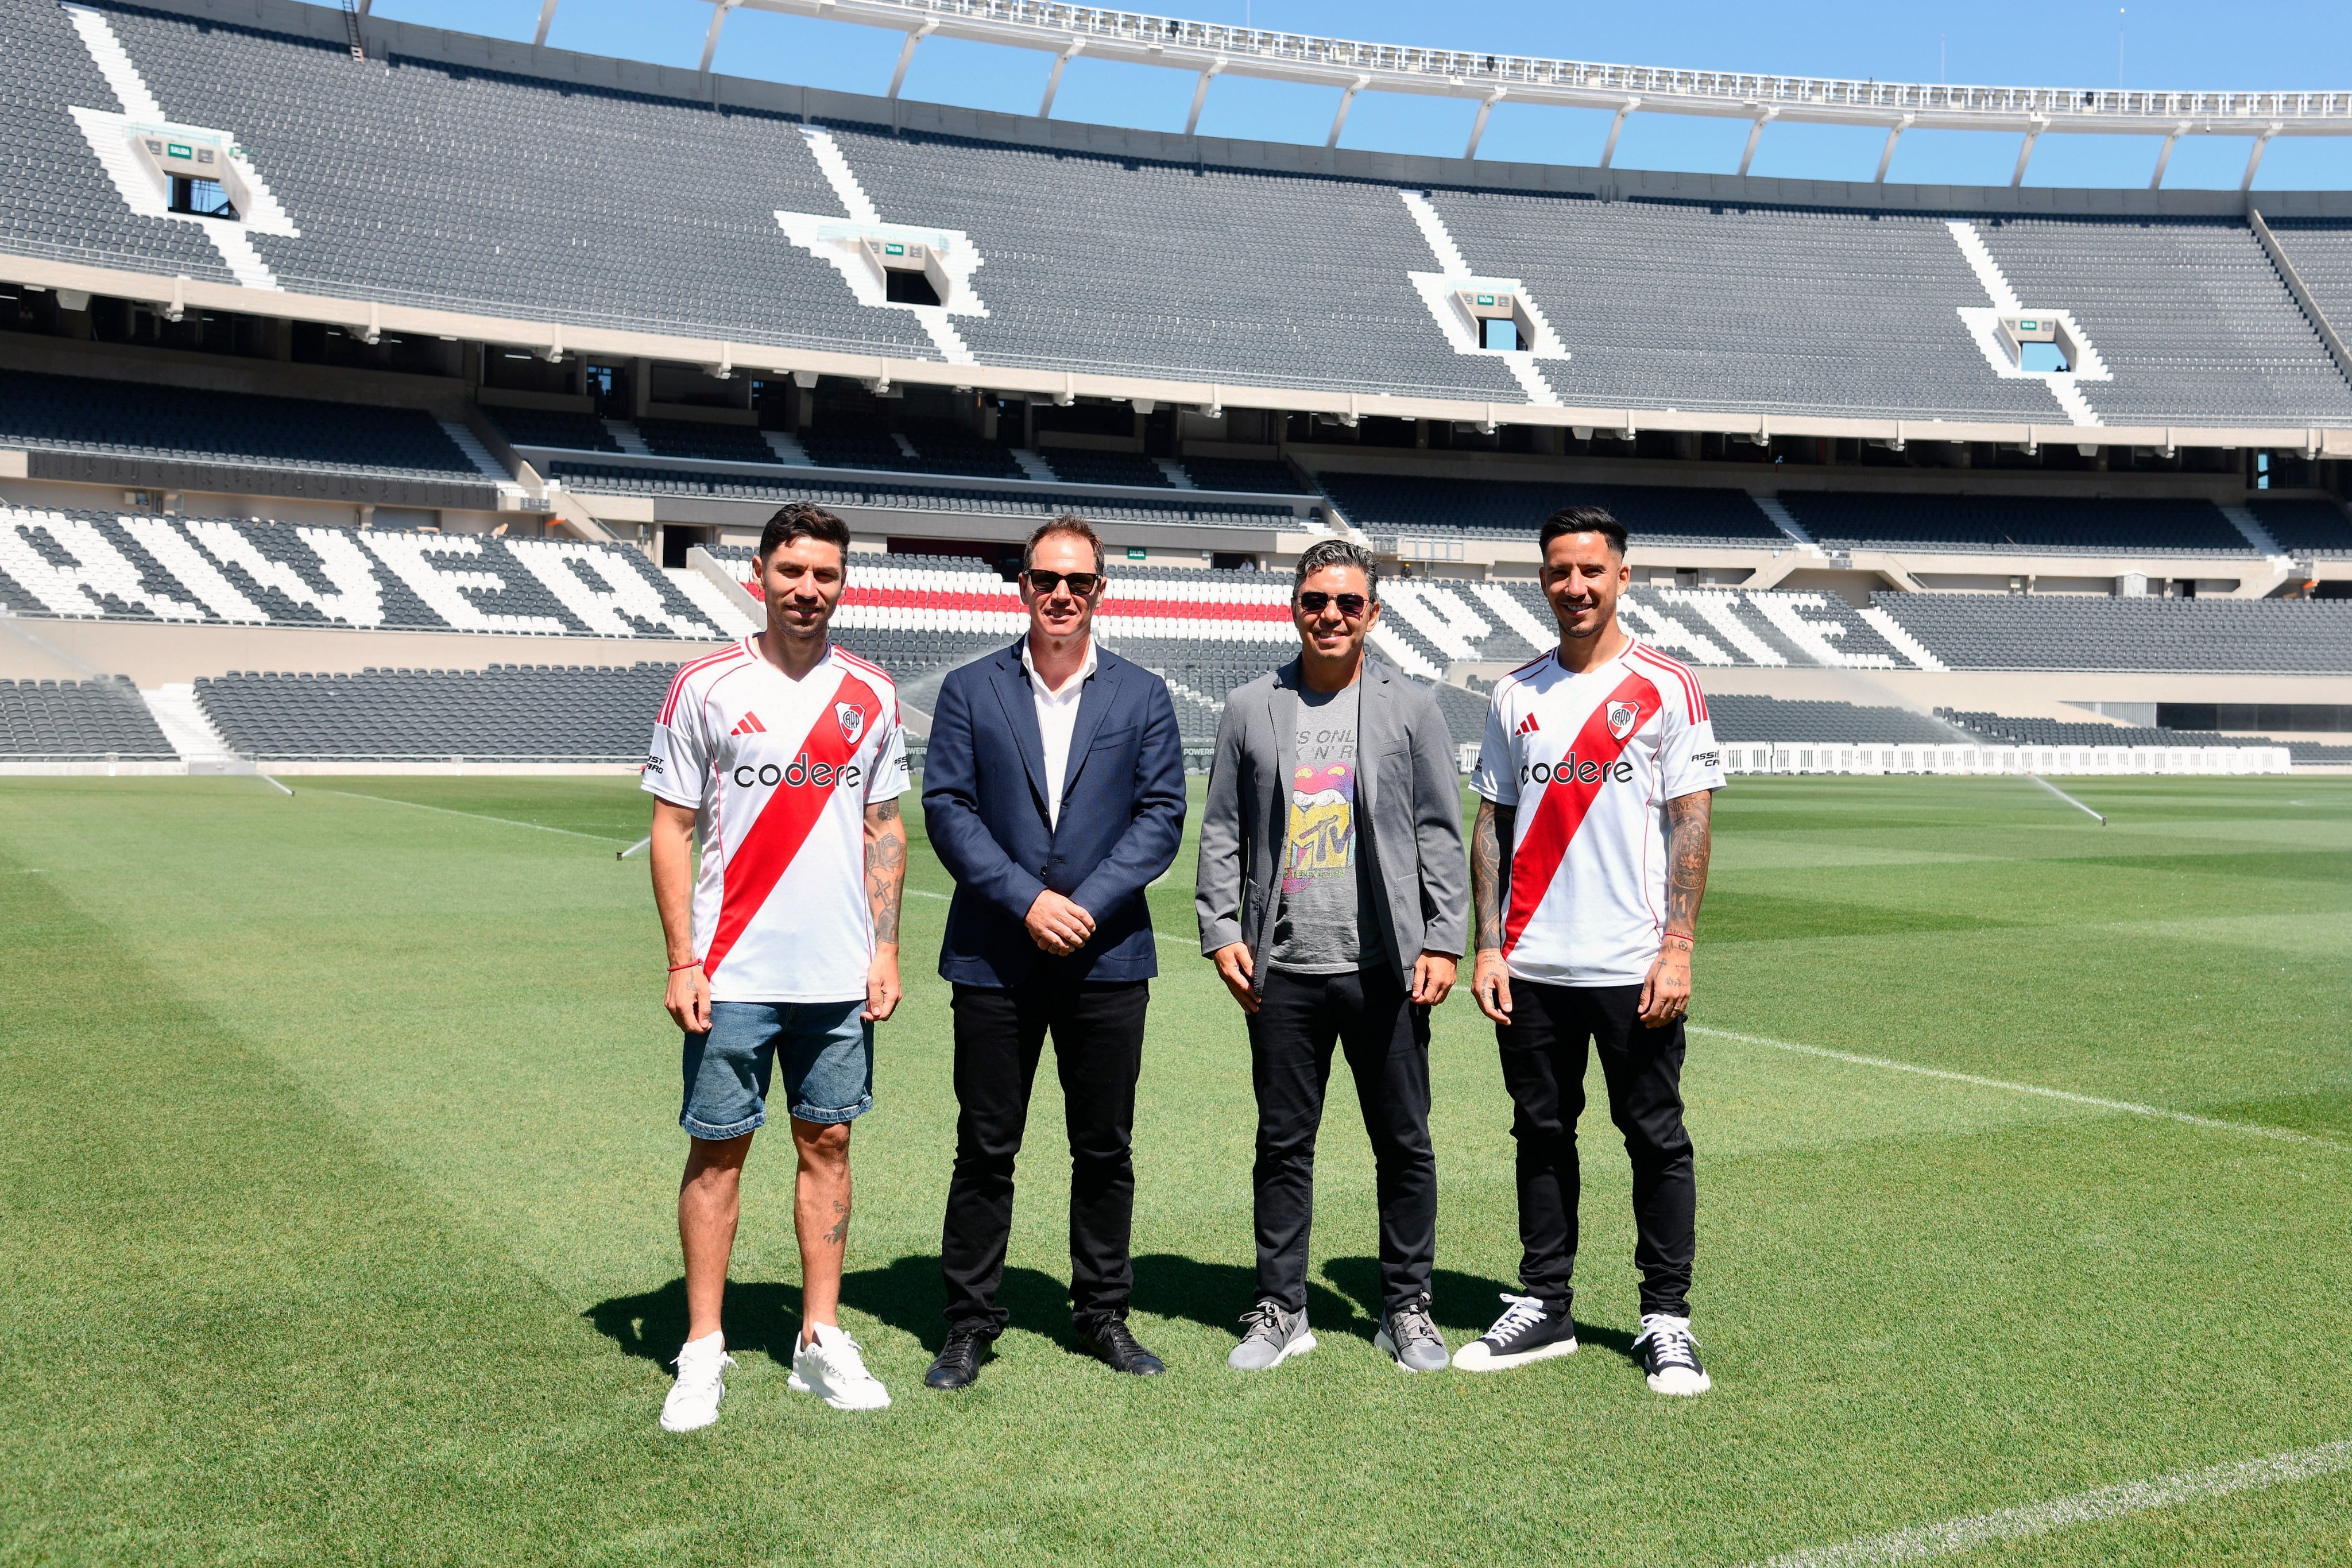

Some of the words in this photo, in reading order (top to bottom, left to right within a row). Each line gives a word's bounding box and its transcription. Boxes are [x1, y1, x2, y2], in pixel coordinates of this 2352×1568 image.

[170, 145, 191, 156] SALIDA
[0, 508, 715, 638] RIVER
[843, 710, 860, 729] CARP
[1612, 708, 1631, 726] CARP
[1338, 745, 1357, 758] R
[734, 753, 861, 787] codere
[1521, 752, 1633, 785] codere
